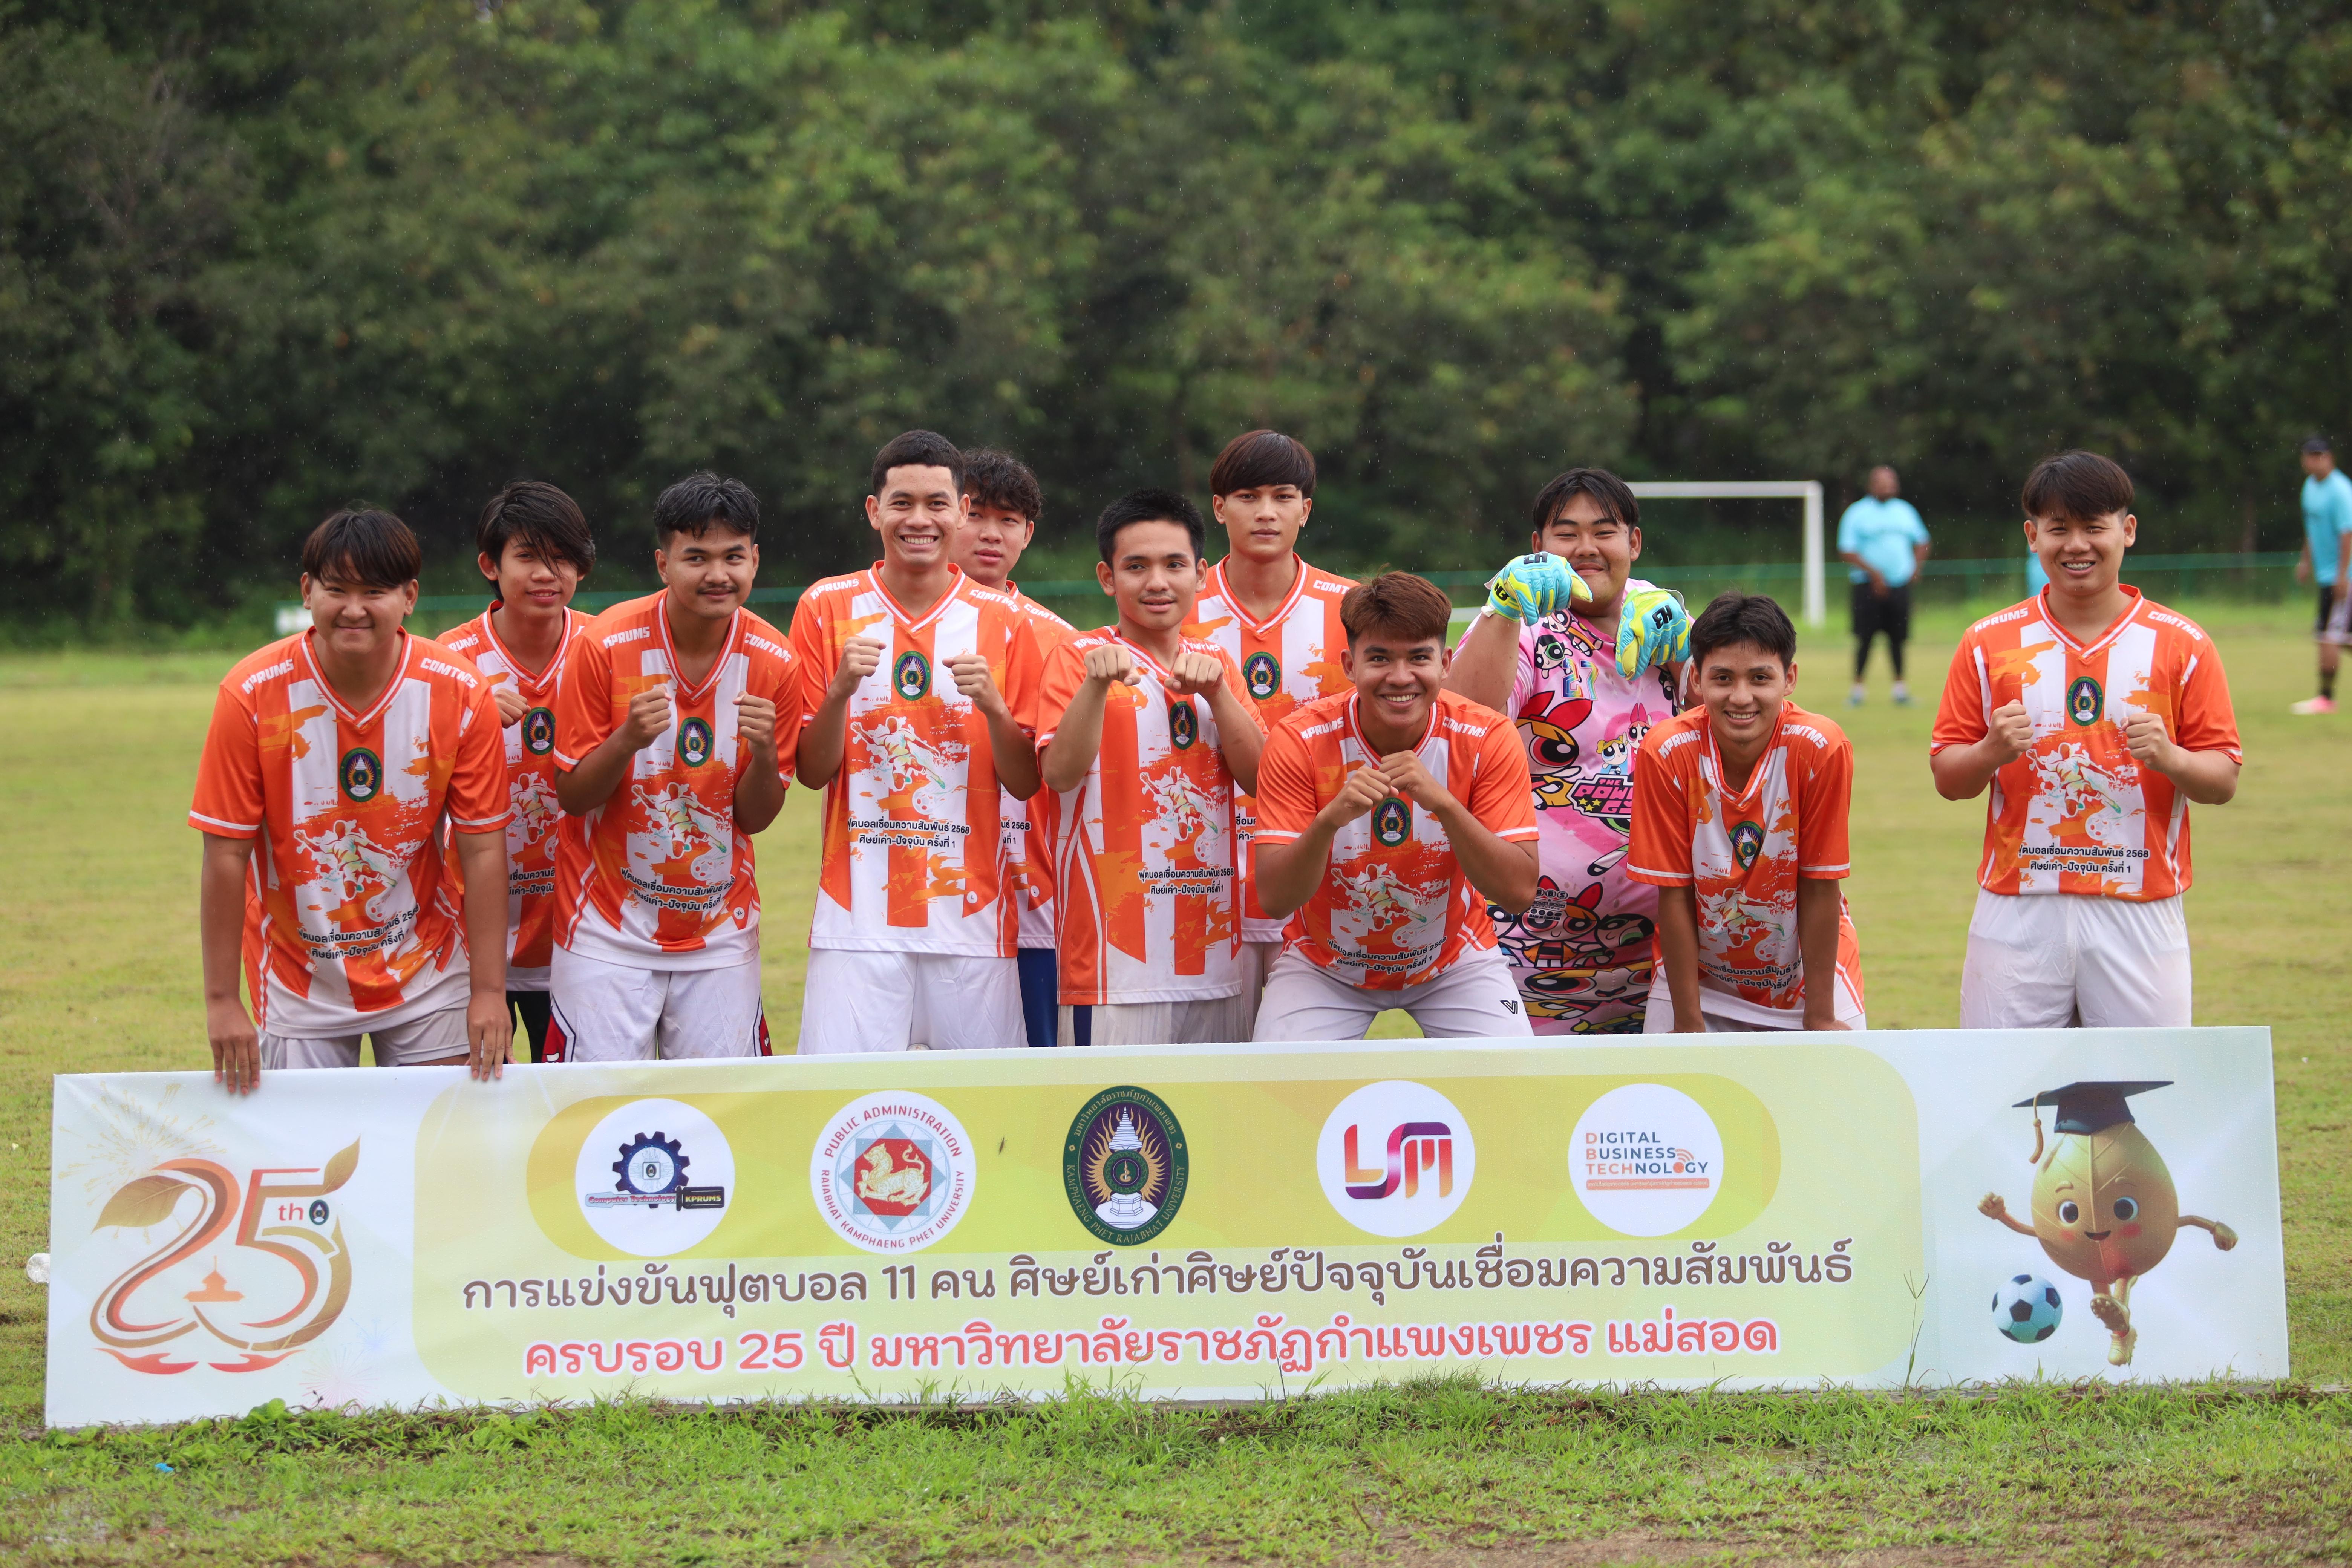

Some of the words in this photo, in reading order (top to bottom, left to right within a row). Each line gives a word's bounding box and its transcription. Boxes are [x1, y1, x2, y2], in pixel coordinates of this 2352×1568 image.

[810, 578, 859, 600] KPRUMS
[1313, 579, 1350, 594] COMT
[969, 589, 1020, 613] COMTMS
[1024, 603, 1073, 630] COMTMS
[2147, 611, 2203, 641] COMTMS
[448, 634, 479, 652] RUMS
[603, 626, 650, 649] KPRUMS
[744, 632, 792, 663] COMTMS
[1073, 637, 1110, 648] KPRUM
[241, 658, 294, 695] KPRUMS
[420, 657, 478, 689] COMTMS
[1562, 658, 1598, 700] 27
[1301, 716, 1344, 739] KPRUMS
[1442, 716, 1488, 738] COMTMS
[1781, 724, 1828, 749] COMTMS
[1658, 730, 1701, 759] KPRUMS
[951, 825, 970, 834] 2568
[1012, 821, 1030, 830] 2568
[2126, 849, 2149, 858] 2568
[1220, 868, 1234, 876] 2568
[824, 1116, 861, 1158] PUBLIC
[864, 1105, 962, 1158] ADMINISTRATION
[1585, 1131, 1661, 1144] DIGITAL
[1586, 1147, 1677, 1160] BUSINESS
[1585, 1162, 1709, 1175] TECHNOLOGY
[588, 1196, 629, 1204] Computer
[630, 1194, 676, 1203] Technology
[685, 1194, 721, 1202] KPRUMS
[840, 1220, 905, 1248] KAMPHAENG
[908, 1227, 935, 1246] PHET
[936, 1170, 965, 1230] UNIVERSITY
[1066, 1164, 1092, 1222] KAMPHAENG
[1090, 1221, 1114, 1240] PHET
[1116, 1220, 1164, 1245] RAJABHAT
[1161, 1165, 1185, 1220] UNIVERSITY
[90, 1157, 354, 1351] 25
[278, 1203, 304, 1222] th
[463, 1264, 868, 1318] การแข่งขันฟุตบอล
[881, 1266, 916, 1300] 11
[932, 1269, 996, 1298] คน
[1009, 1233, 1852, 1306] ศิษย์เก่าศิษย์ปัจจุบันเชื่อมความสัมพันธ์
[527, 1341, 722, 1374] ครบรอบ
[740, 1333, 803, 1369] 25
[819, 1323, 856, 1368] ปี
[872, 1315, 1591, 1372] มหาวิทยาลัยราชภัฏกำแพงเพชร
[1609, 1308, 1776, 1354] แม่สอด
